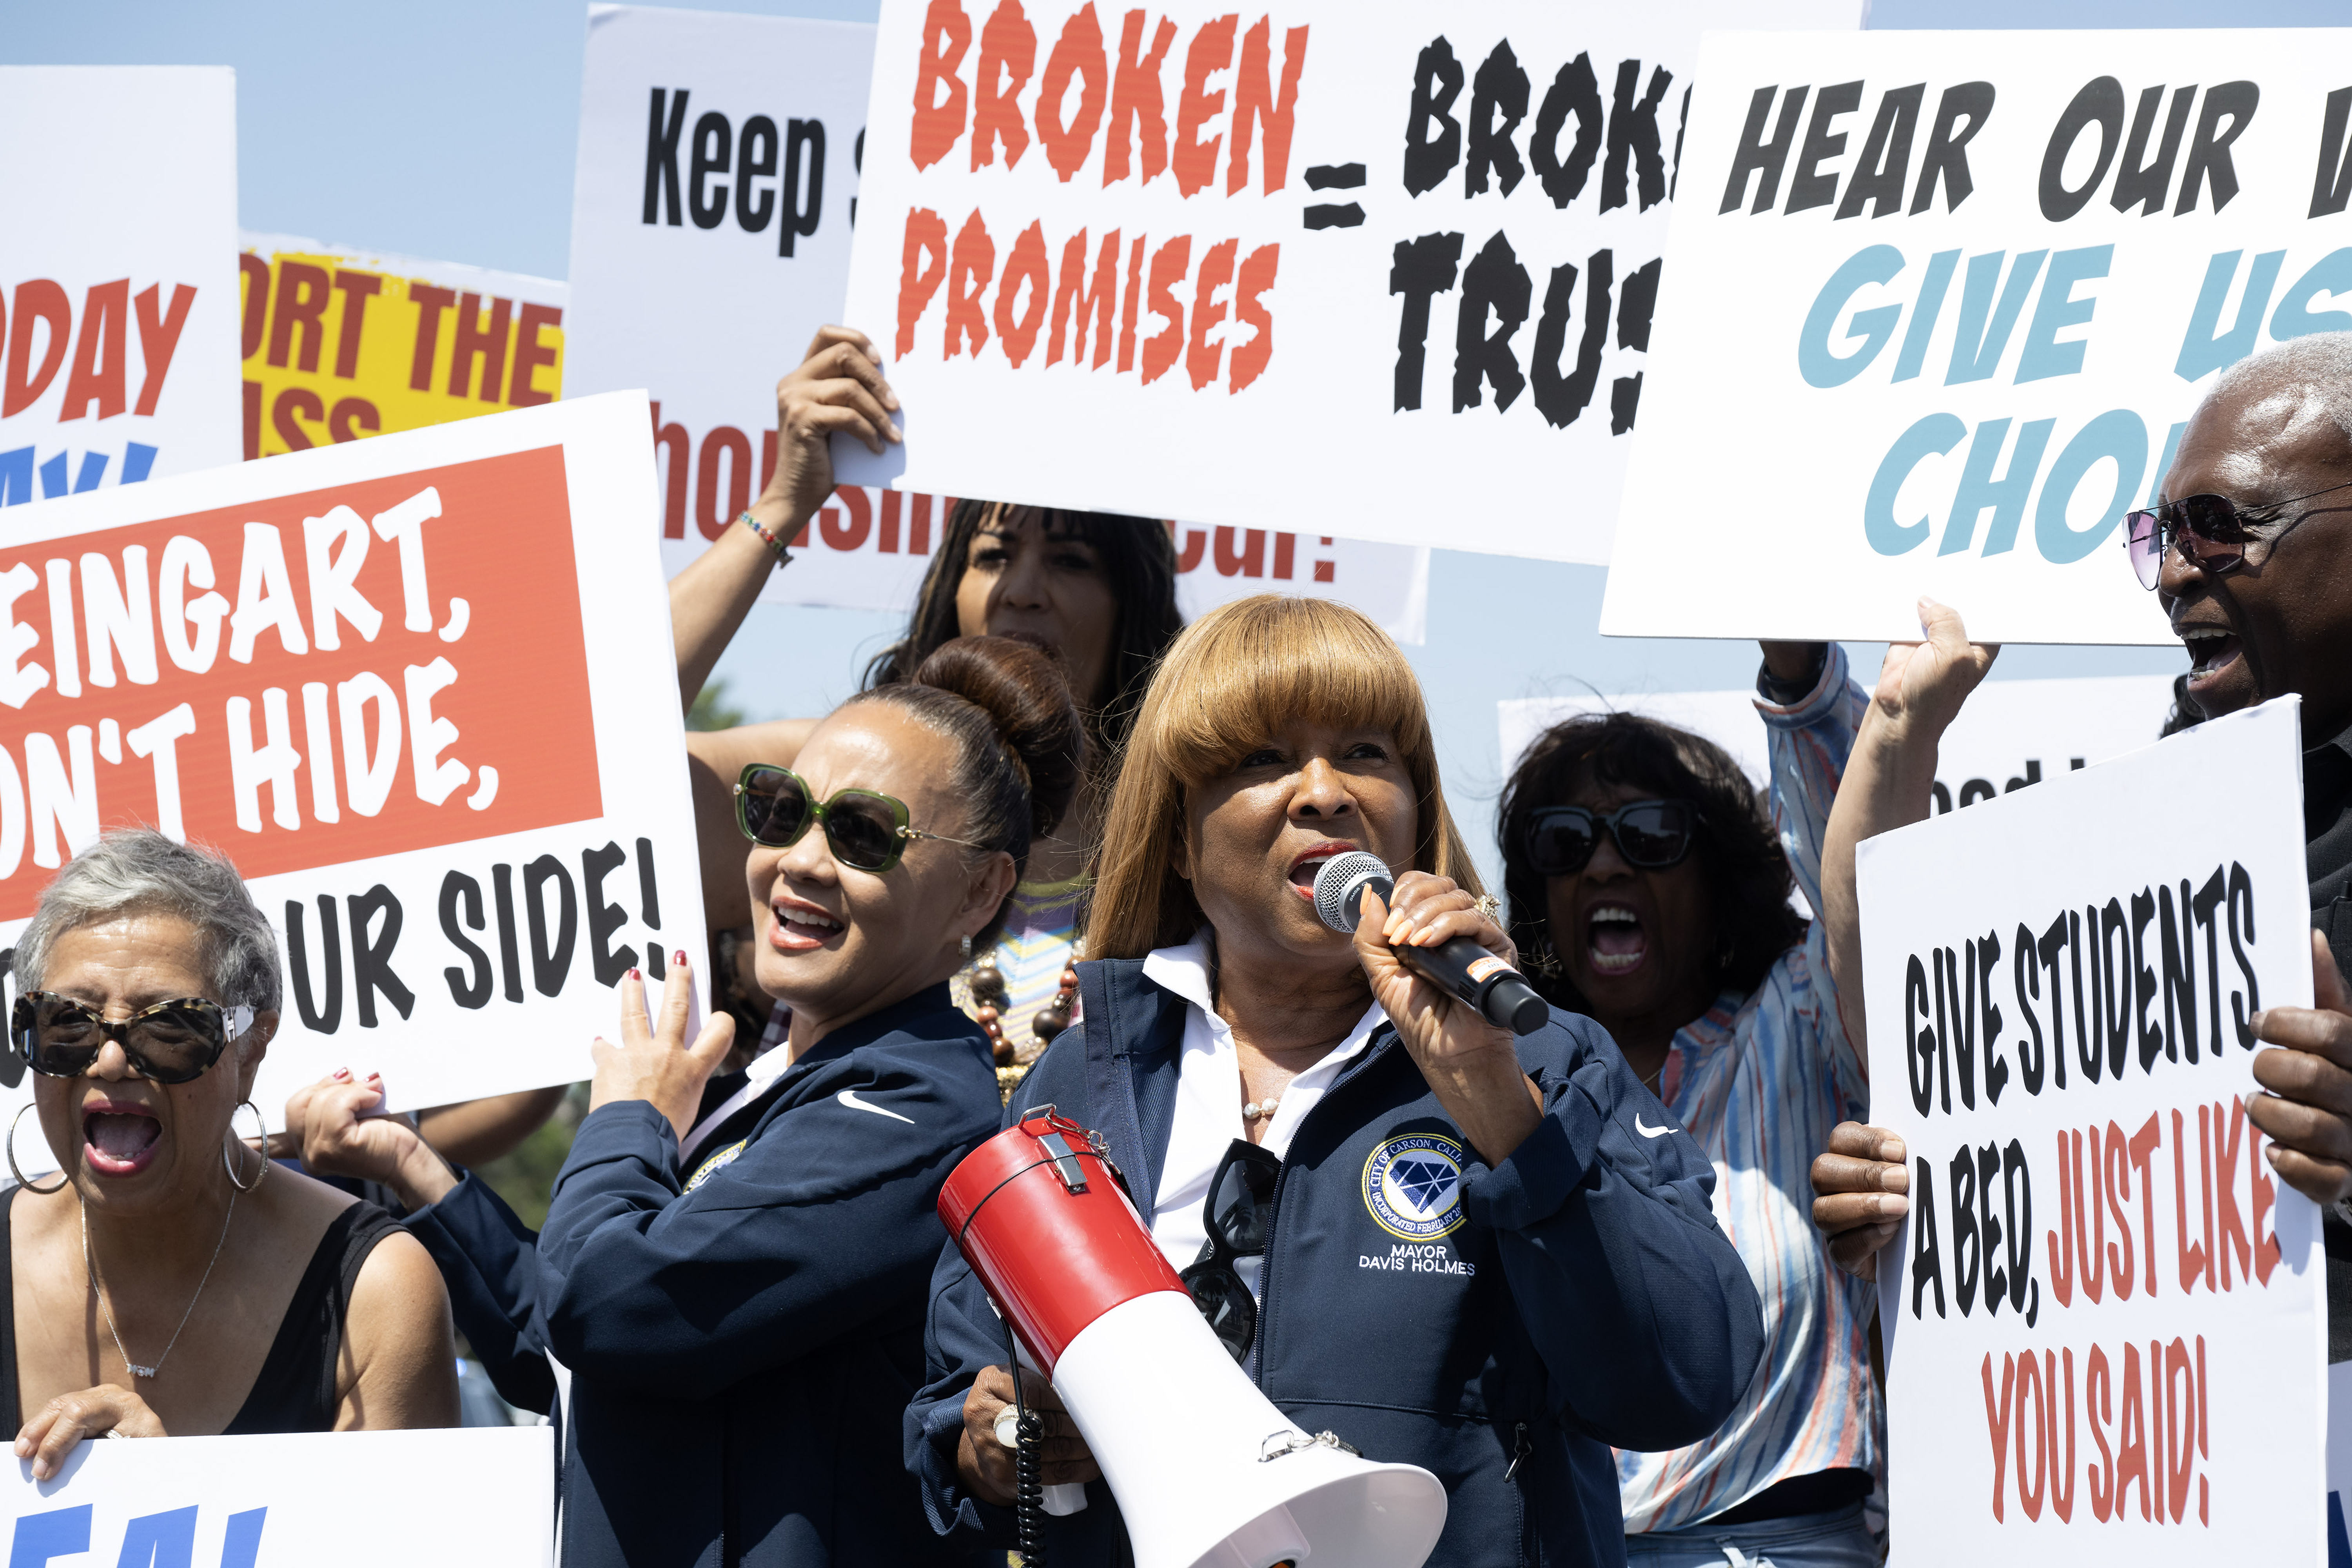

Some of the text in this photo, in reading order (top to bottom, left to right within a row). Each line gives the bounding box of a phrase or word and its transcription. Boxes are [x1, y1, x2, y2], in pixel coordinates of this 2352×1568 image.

[642, 87, 826, 258] Keep
[910, 0, 1310, 200] BROKEN
[1403, 34, 1693, 216] BROK
[1719, 79, 1996, 221] HEAR
[2038, 75, 2260, 222] OUR
[0, 278, 198, 423] DAY
[409, 280, 564, 408] THE
[895, 206, 1281, 396] PROMISES
[1798, 243, 2116, 388] GIVE
[0, 486, 470, 709] EINGART,
[225, 656, 500, 833] HIDE,
[285, 837, 667, 1035] UR SIDE!
[1905, 860, 2259, 1119] GIVE STUDENTS
[1369, 1165, 1384, 1187] CITY
[1378, 1150, 1391, 1163] OF
[1390, 1139, 1432, 1154] CARSON,
[1372, 1191, 1416, 1231] INCORPORATED
[1417, 1212, 1454, 1232] FEBRUARY
[1911, 1093, 2282, 1329] A BED, JUST LIKE
[1359, 1255, 1476, 1277] DAVIS HOLMES
[1390, 1244, 1447, 1259] MAYOR
[1981, 1334, 2209, 1529] YOU SAID!
